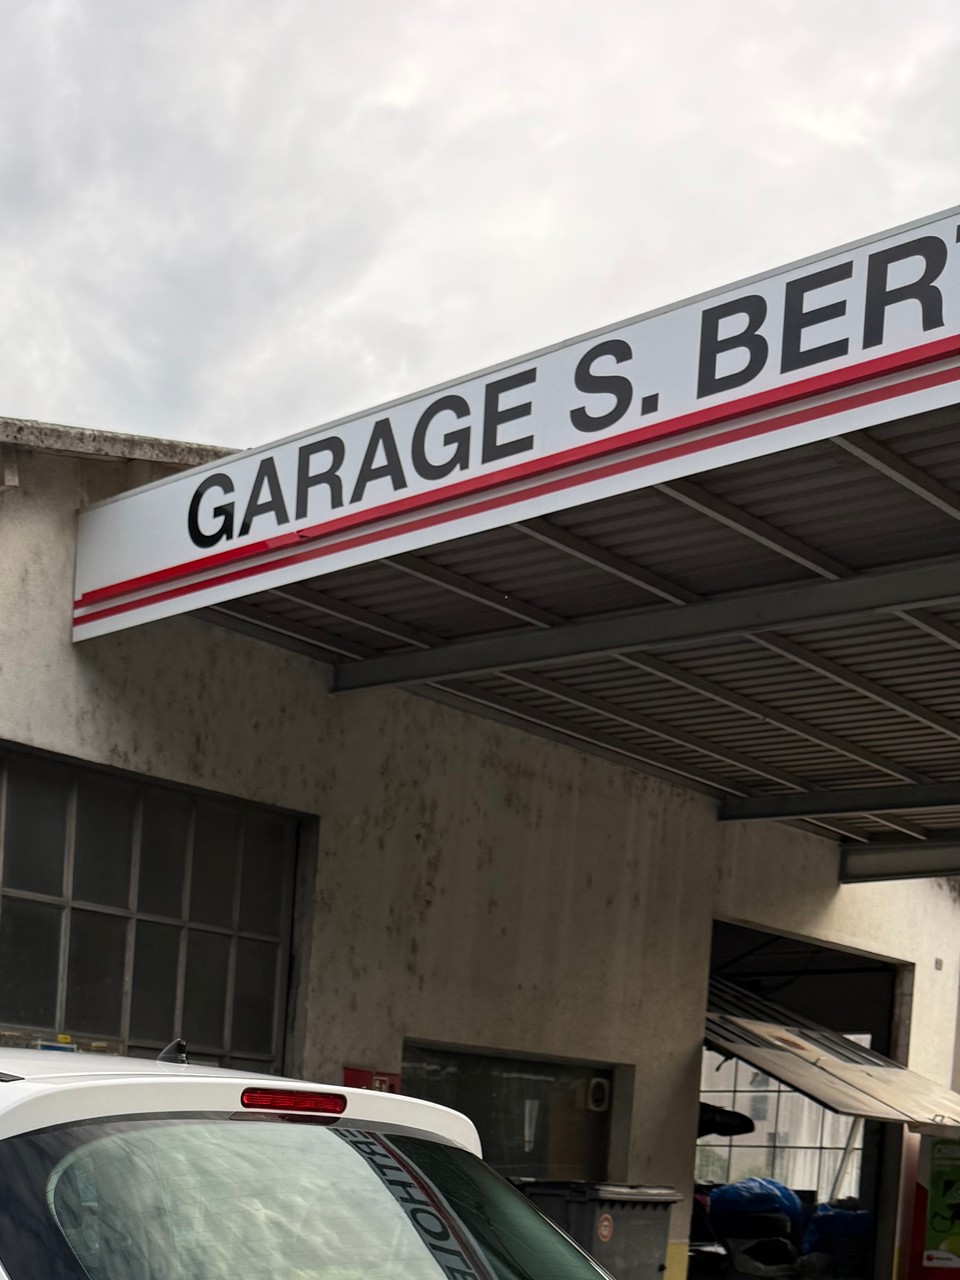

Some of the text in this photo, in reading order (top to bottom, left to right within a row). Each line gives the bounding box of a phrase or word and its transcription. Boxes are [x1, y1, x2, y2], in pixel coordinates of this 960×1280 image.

[187, 225, 960, 549] GARAGE S. BER
